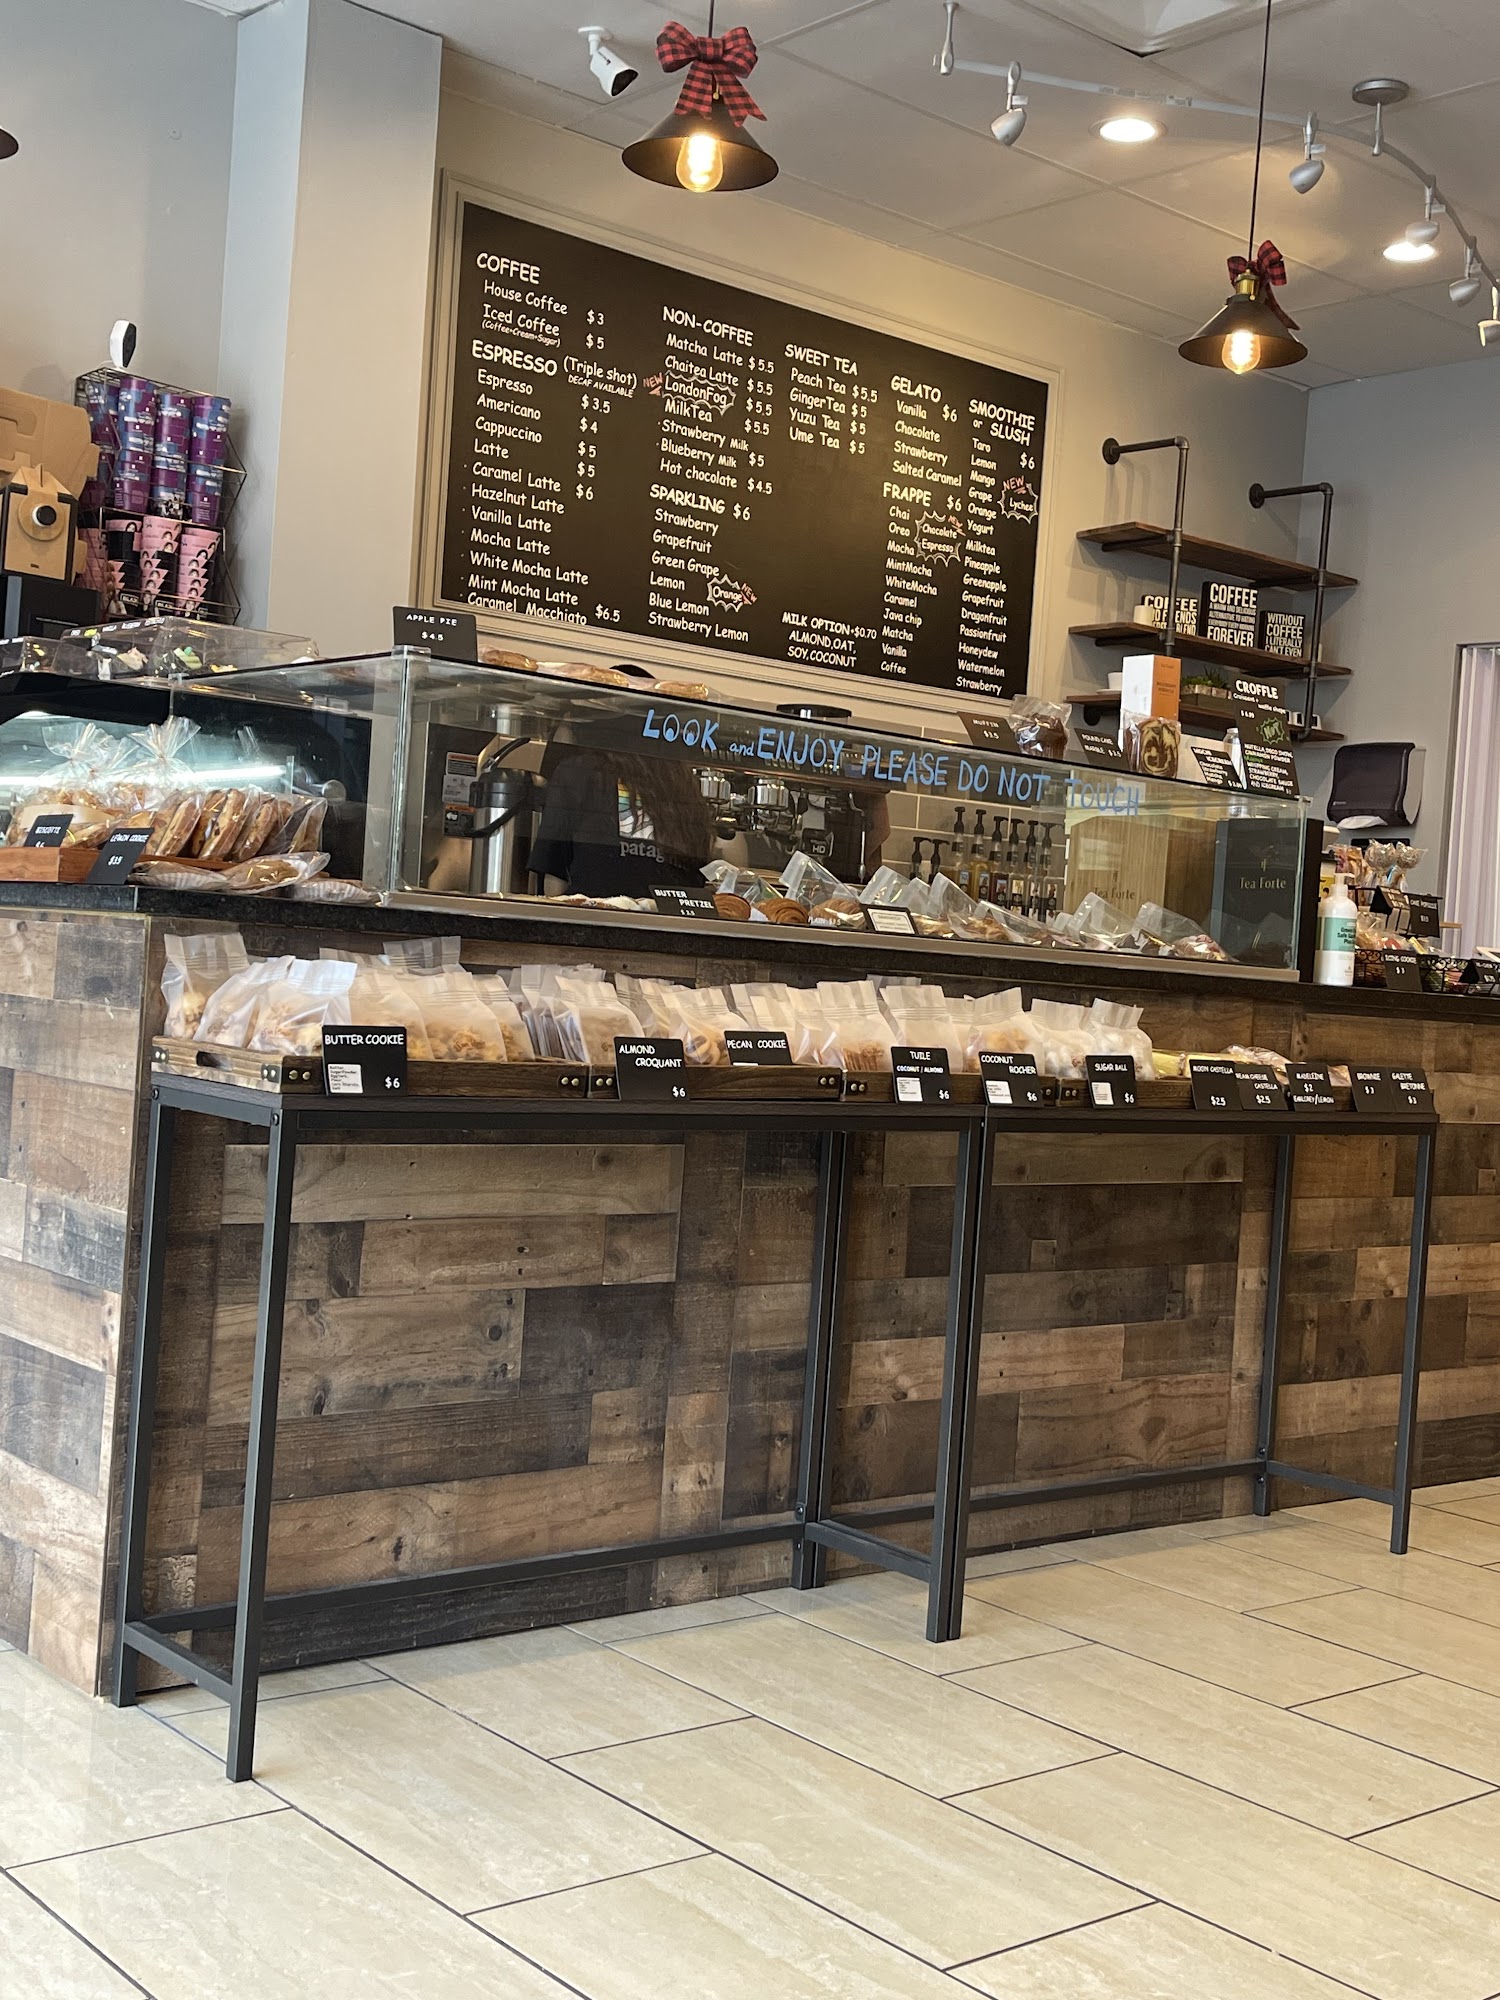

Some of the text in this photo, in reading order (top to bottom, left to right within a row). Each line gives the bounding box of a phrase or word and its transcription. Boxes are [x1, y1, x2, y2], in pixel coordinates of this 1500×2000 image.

[476, 252, 541, 284] COFFEE
[484, 279, 568, 315] House Coffee
[483, 303, 560, 336] Iced Coffee
[662, 305, 754, 347] NON-COFFEE
[666, 333, 743, 366] Matcha Latte
[784, 343, 858, 376] SWEET TEA
[472, 339, 638, 390] ESPRESSO (Triple shot)
[664, 355, 739, 387] Chaitea Latte
[477, 368, 533, 395] Espresso
[567, 374, 634, 398] DECAF AVAILABLE
[790, 367, 846, 395] Peach Tea
[890, 375, 941, 402] GELATO
[476, 393, 541, 421] Americano
[664, 398, 712, 423] MilkTea
[789, 387, 846, 414] GingerTea
[896, 399, 927, 420] Vanilla
[789, 406, 841, 431] Yuzu Tea
[968, 399, 1035, 431] SMOOTHIE
[475, 416, 542, 443] Cappuccino
[661, 419, 749, 452] Strawberry Milk
[789, 426, 840, 449] Ume Tea
[894, 420, 941, 443] Chocolate
[972, 419, 1031, 447] or SLUSH
[473, 438, 510, 459] Latte
[660, 437, 737, 468] Blueberry Milk
[893, 440, 948, 467] Strawberry
[972, 437, 991, 453] Taro
[970, 454, 997, 471] Lemon
[472, 461, 562, 493] Caramel Latte
[659, 458, 738, 488] Hot chocolate
[892, 460, 962, 487] Salted Caramel
[969, 470, 996, 488] Mango
[1002, 475, 1025, 491] NEW
[471, 482, 565, 515] Hazelnut Latte
[649, 483, 726, 514] SPARKLING
[882, 481, 932, 507] FRAPPE
[968, 486, 993, 505] Grape
[889, 505, 911, 520] Chai
[967, 502, 997, 521] Orange
[1009, 497, 1034, 512] Lychee
[471, 504, 552, 533] Vanilla Latte
[654, 508, 719, 536] Strawberry
[966, 519, 994, 536] Yogurt
[888, 522, 911, 537] Oreo
[922, 523, 958, 539] Chocolate
[470, 528, 551, 556] Mocha Latte
[652, 529, 712, 553] Grapefruit
[886, 540, 915, 556] Mocha
[921, 538, 954, 553] Espresso
[965, 540, 996, 556] Milktea
[470, 550, 589, 585] White Mocha Latte
[651, 550, 720, 579] Green Grape
[885, 557, 932, 577] MintMocha
[964, 555, 1001, 575] Pineapple
[468, 574, 579, 606] Mint Mocha Latte
[650, 571, 685, 590] Lemon
[885, 574, 938, 596] WhiteMocha
[963, 573, 1007, 593] Greenapple
[649, 592, 710, 616] Blue Lemon
[712, 586, 743, 603] Orange
[883, 591, 918, 608] Caramel
[961, 590, 1004, 609] Grapefruit
[1210, 583, 1258, 609] COFFEE
[467, 592, 588, 626] Caramel Macchiato
[782, 611, 808, 627] MILK
[883, 607, 923, 628] Java chip
[961, 607, 1007, 626] Dragonfruit
[406, 614, 458, 626] APPLE PIE
[648, 612, 749, 642] Strawberry Lemon
[1267, 612, 1304, 627] WITHOUT
[882, 625, 914, 641] Matcha
[959, 624, 1007, 643] Passionfruit
[1207, 626, 1254, 647] FOREVER
[1266, 623, 1304, 640] COFFEE
[881, 642, 907, 658] Vanilla
[958, 641, 999, 659] Honeydew
[1269, 636, 1303, 648] LITERALLY
[880, 660, 907, 675] Coffee
[957, 659, 1005, 677] Watermelon
[955, 676, 1002, 696] Strawberry
[1235, 680, 1279, 700] CROFFLE
[972, 718, 999, 728] MUFFIN
[642, 708, 1141, 817] LOOK and ENJOY PLEASE DO NOT TOUCH
[812, 844, 826, 854] HD
[1239, 877, 1256, 890] Tea
[654, 889, 688, 899] BUTTER
[678, 899, 715, 909] PRETZEL
[324, 1034, 404, 1045] BUTTER COOKIE
[619, 1044, 655, 1055] ALMOND
[726, 1039, 787, 1049] PECAN COOKIE
[635, 1058, 682, 1069] CROQUANT
[909, 1050, 931, 1061] TUILE
[980, 1054, 1013, 1064] COCONUT
[896, 1065, 943, 1074] COCONUT ALMOND
[1008, 1065, 1037, 1075] ROCHER
[1094, 1062, 1128, 1072] SUGAR BALL
[1209, 1065, 1234, 1075] CASTELLA
[672, 1086, 686, 1098] $6
[939, 1089, 950, 1100] $6
[1254, 1082, 1279, 1090] CASTELLA
[1303, 1083, 1314, 1093] $2
[1026, 1091, 1038, 1102] $6
[1124, 1092, 1135, 1104] $6
